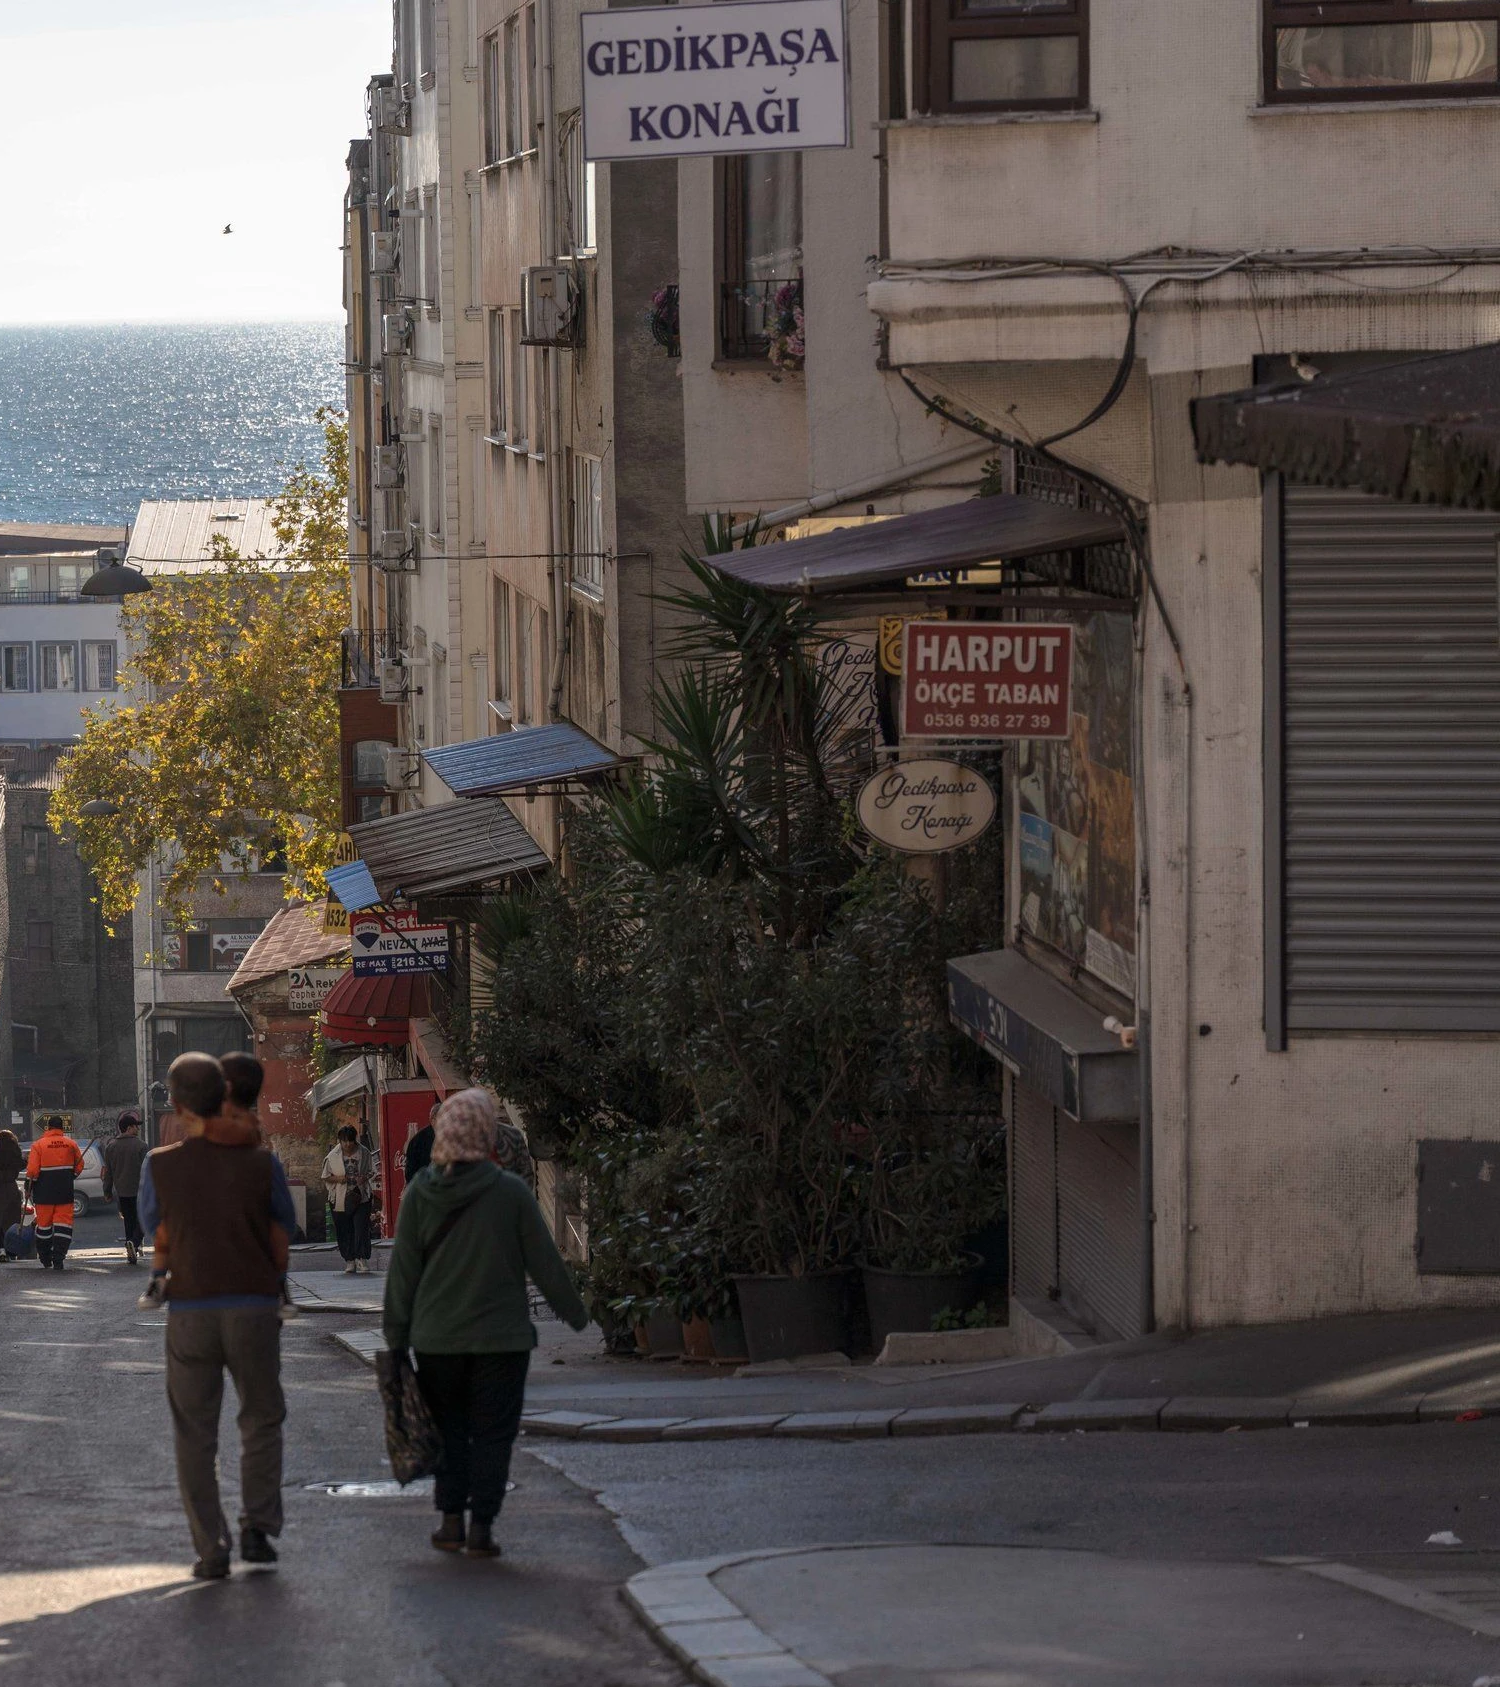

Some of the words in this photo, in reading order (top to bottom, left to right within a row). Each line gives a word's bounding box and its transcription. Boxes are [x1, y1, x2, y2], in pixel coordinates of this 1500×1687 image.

[587, 26, 839, 77] GEDİKPAŞA
[629, 86, 800, 142] KONAĞI
[916, 635, 1061, 673] HARPUT
[915, 678, 976, 708] ÖKÇE
[984, 683, 1060, 705] TABAN
[924, 713, 964, 727] 0536
[970, 714, 999, 727] 936
[1005, 714, 1025, 727] 27
[1030, 714, 1051, 728] 39
[397, 957, 415, 967] 216
[433, 955, 446, 965] 86
[290, 990, 316, 1000] Cephe
